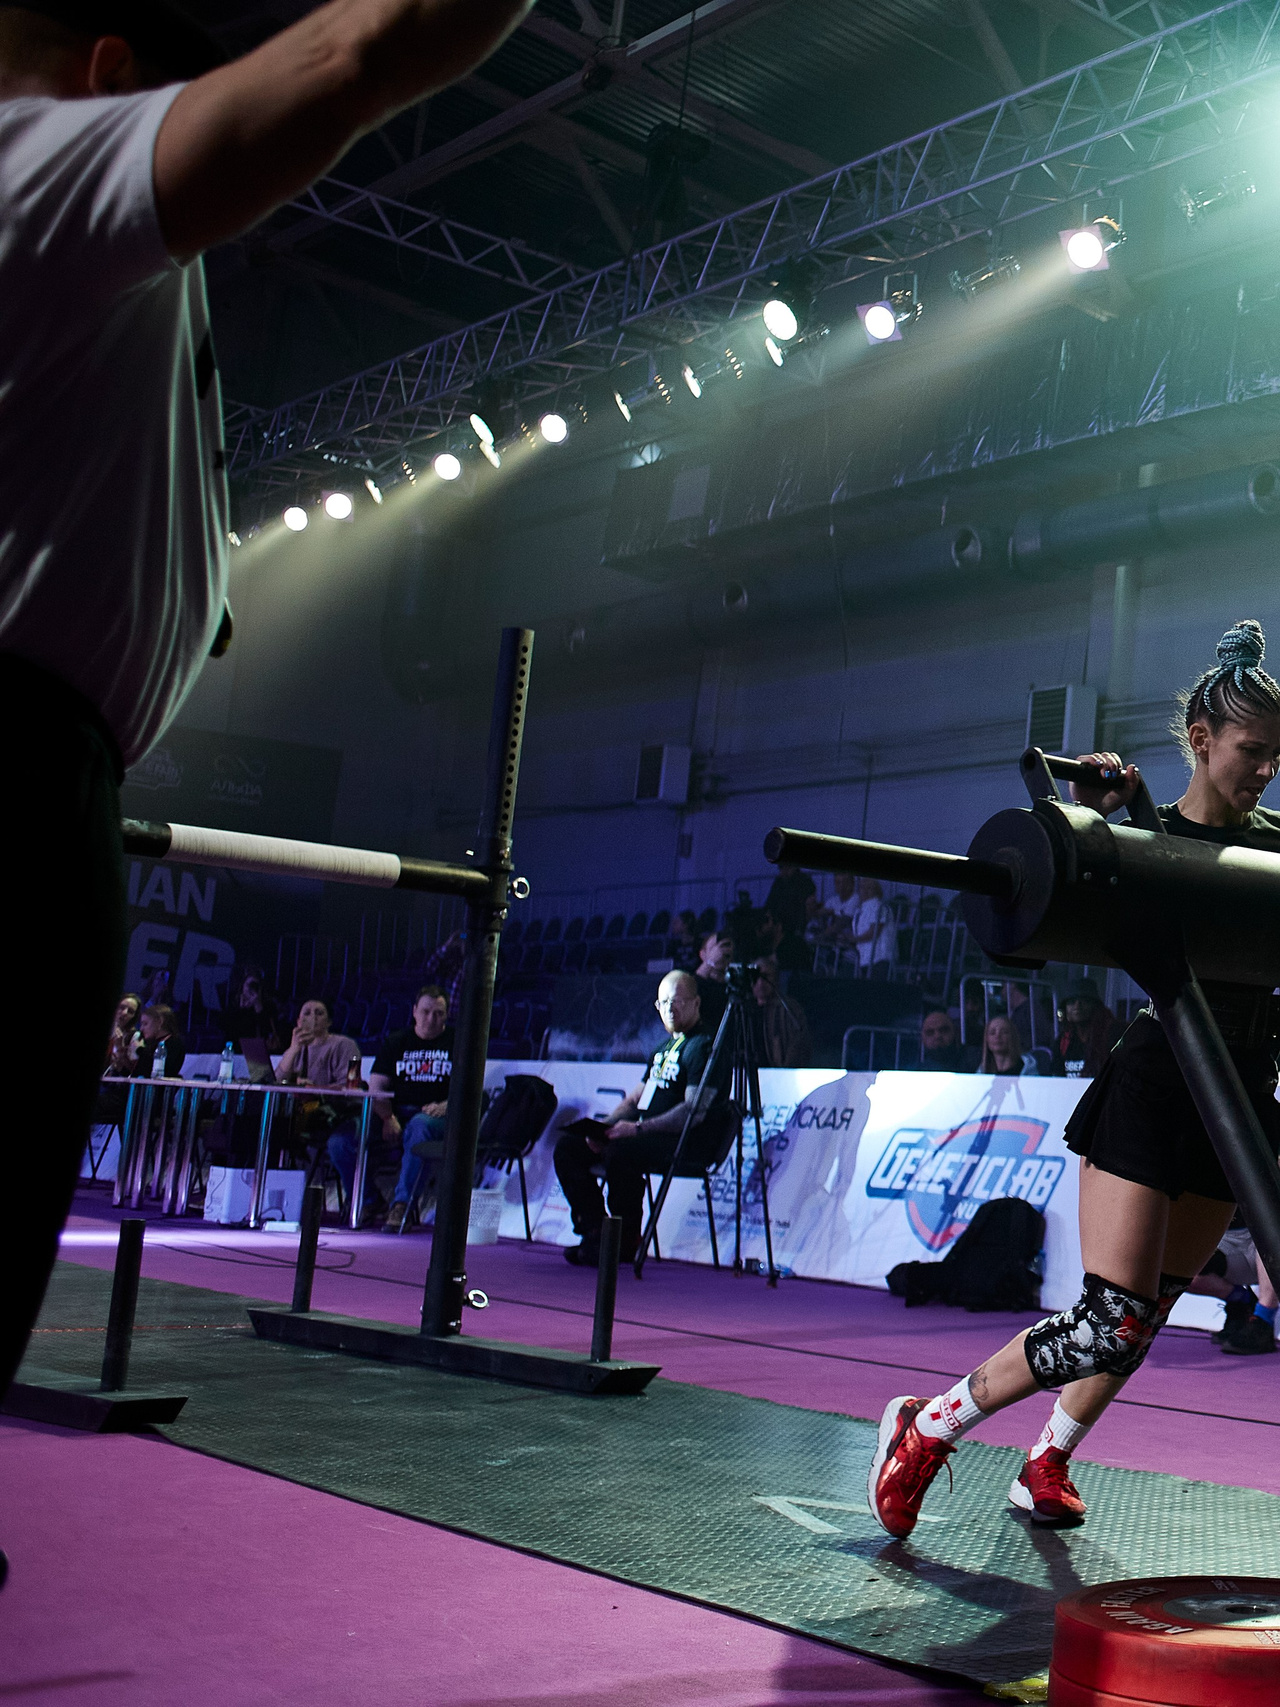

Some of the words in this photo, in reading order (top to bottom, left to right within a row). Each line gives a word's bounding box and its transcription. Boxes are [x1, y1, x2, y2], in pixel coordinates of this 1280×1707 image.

[127, 861, 217, 922] IAN
[123, 921, 236, 1012] ER
[395, 1060, 453, 1077] POWER
[757, 1103, 855, 1131] СЕЙСКАЯ
[869, 1131, 1063, 1206] GENETICLAB
[953, 1201, 980, 1220] NU
[1100, 1586, 1168, 1609] FASTER
[1105, 1610, 1195, 1636] AGAIN
